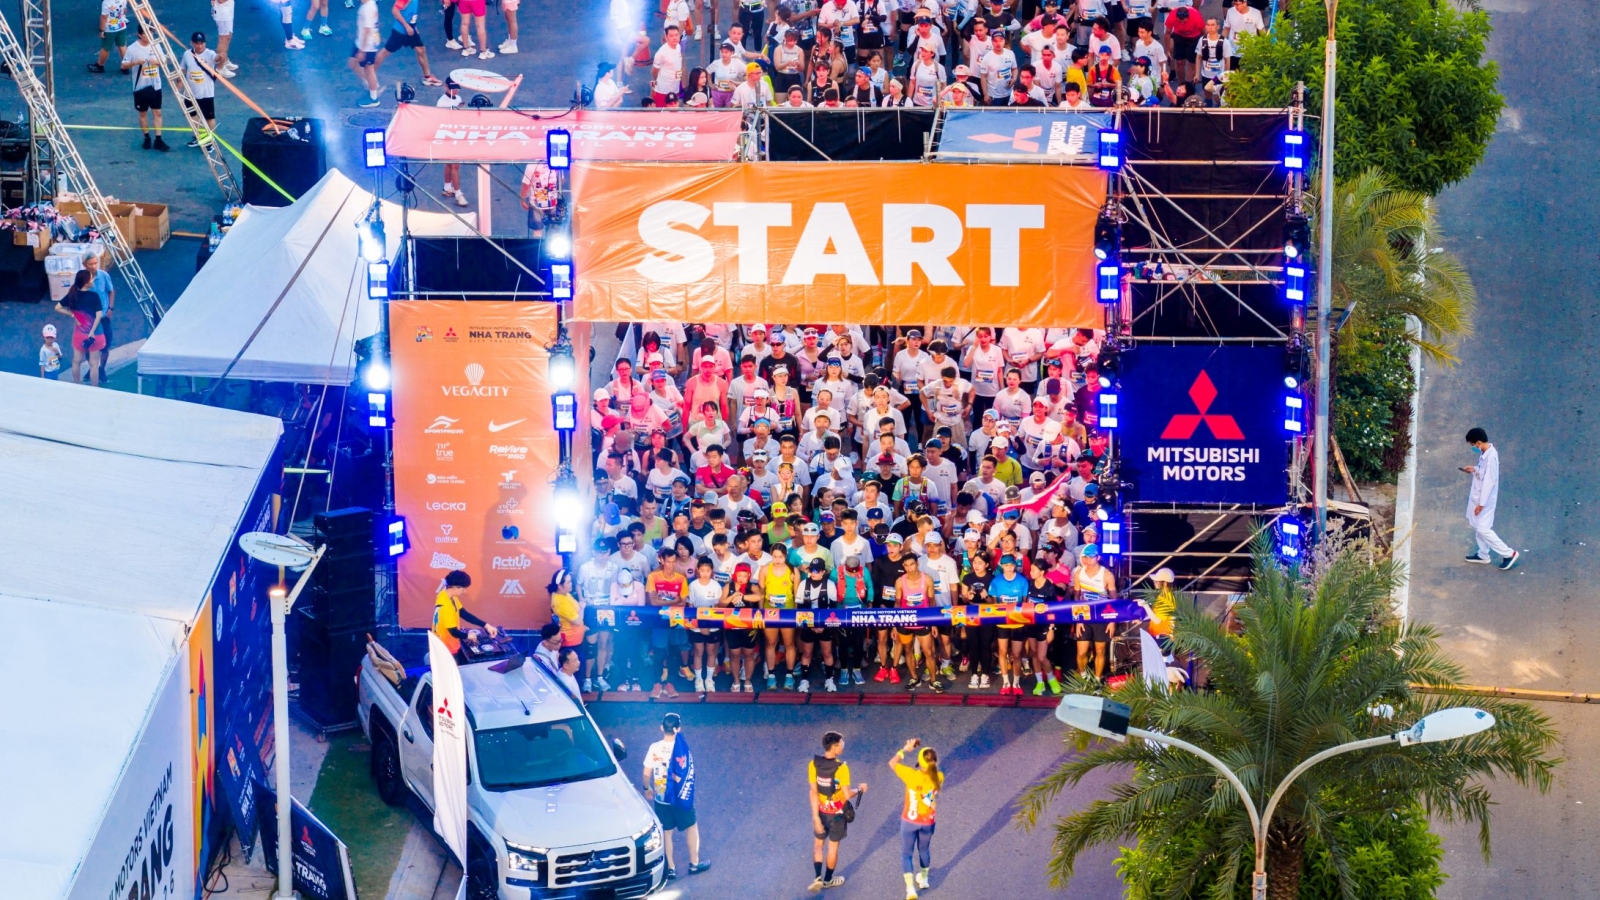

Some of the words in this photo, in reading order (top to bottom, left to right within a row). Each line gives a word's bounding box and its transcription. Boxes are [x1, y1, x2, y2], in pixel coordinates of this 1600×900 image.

[439, 123, 536, 131] MITSUBISHI
[434, 129, 531, 140] NHA
[544, 130, 696, 141] RANG
[634, 199, 1045, 287] START
[495, 331, 532, 339] TRANG
[441, 386, 509, 397] VEGACITY
[436, 449, 454, 457] true
[1147, 446, 1260, 463] MITSUBISHI
[1163, 465, 1246, 482] MOTORS
[851, 614, 877, 624] NHA
[878, 613, 918, 623] TRANG
[115, 826, 143, 898] MOTORS
[143, 760, 172, 839] VIETNAM
[296, 861, 327, 891] TRANG
